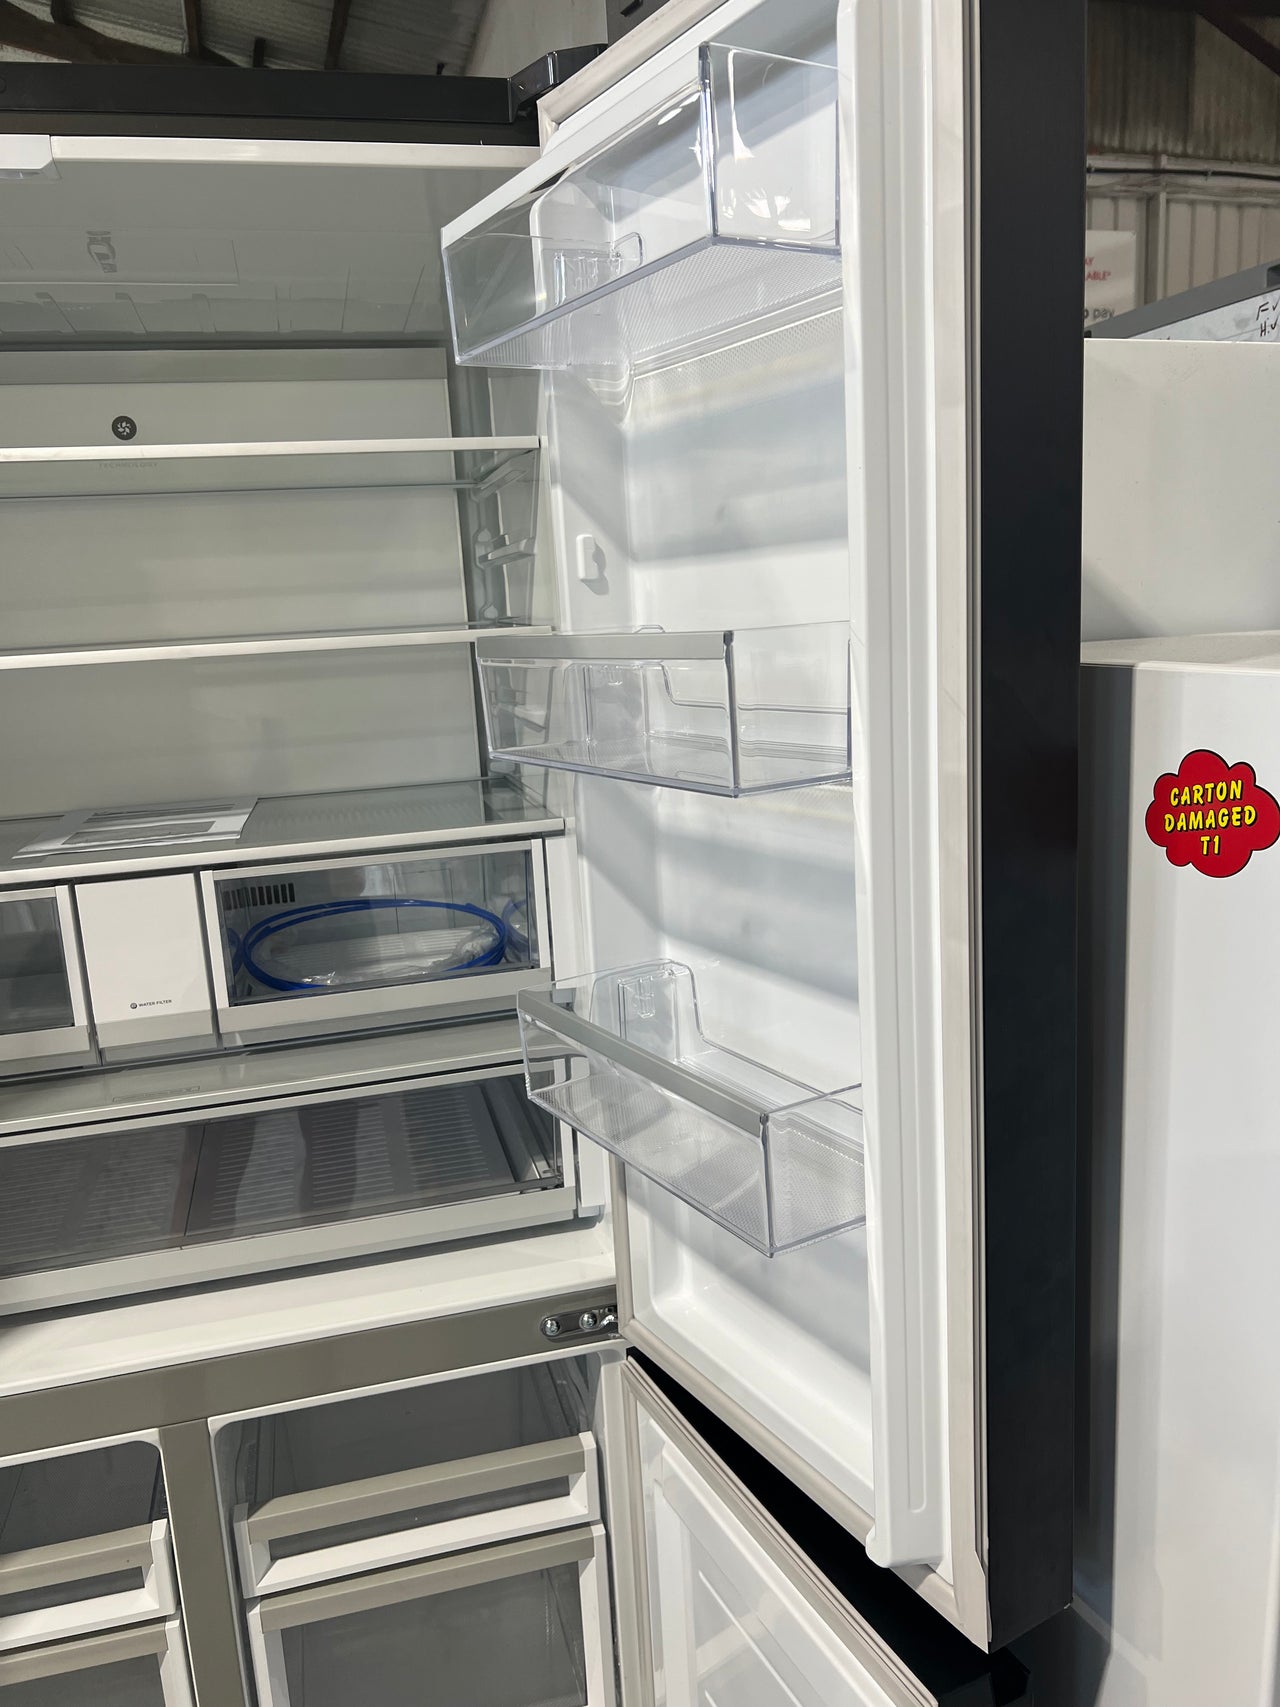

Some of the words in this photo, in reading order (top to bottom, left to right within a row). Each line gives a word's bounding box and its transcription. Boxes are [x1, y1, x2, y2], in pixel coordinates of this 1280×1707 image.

[1170, 780, 1243, 807] CARTON
[1164, 805, 1257, 833] DAMAGED
[1200, 835, 1220, 856] T1
